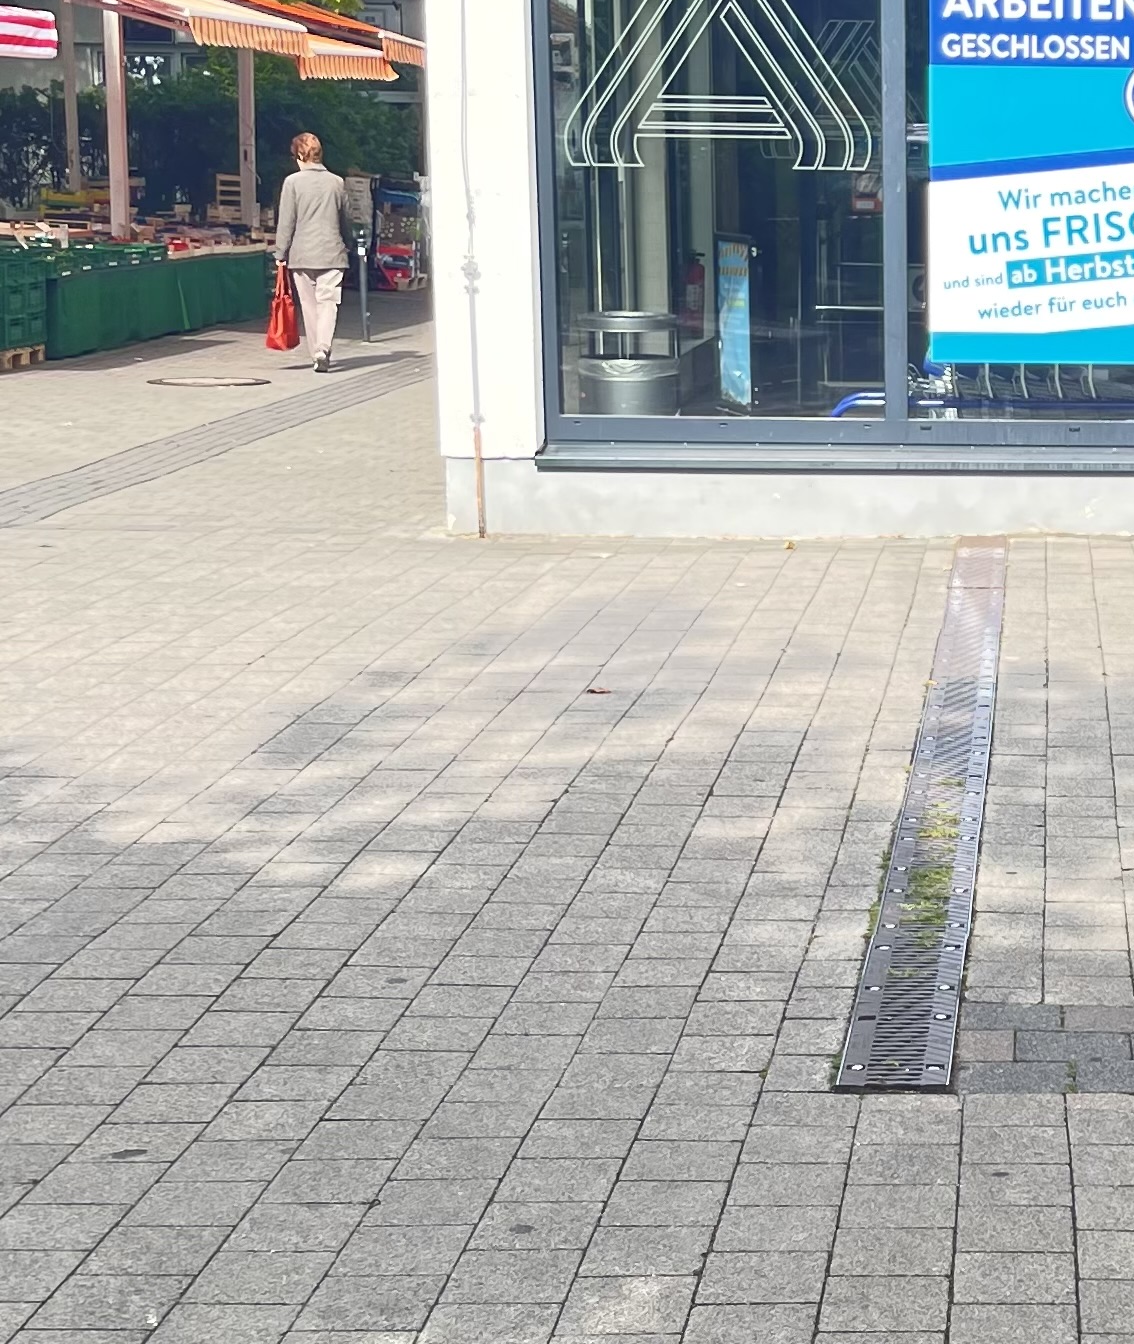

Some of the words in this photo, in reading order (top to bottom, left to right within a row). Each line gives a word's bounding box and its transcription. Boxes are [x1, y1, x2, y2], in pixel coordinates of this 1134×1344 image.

[941, 33, 1130, 60] GESCHLOSSEN
[998, 188, 1042, 211] Wir
[969, 228, 1030, 255] uns
[944, 276, 969, 290] und
[975, 273, 1003, 288] sind
[1012, 264, 1037, 285] ab
[978, 300, 1041, 319] wieder
[1048, 295, 1077, 314] für
[1083, 290, 1128, 310] euch
